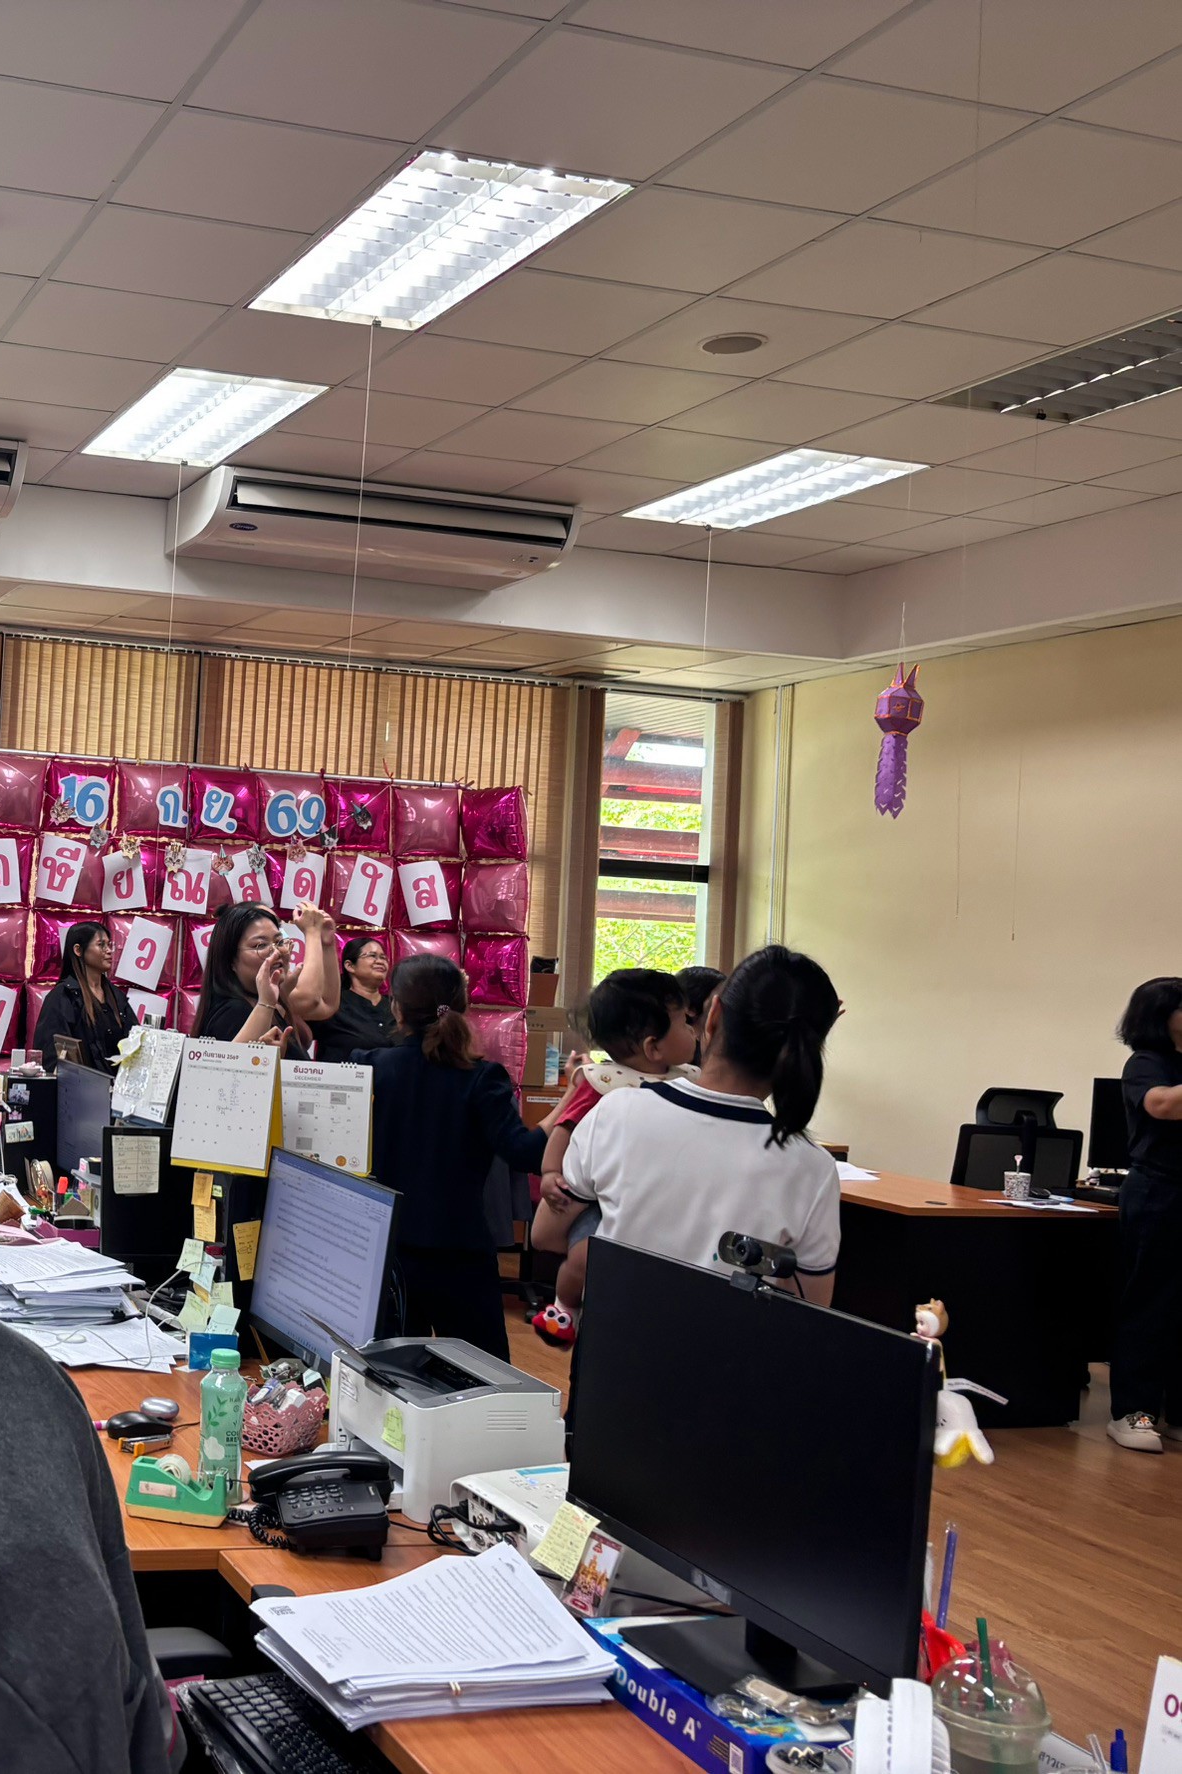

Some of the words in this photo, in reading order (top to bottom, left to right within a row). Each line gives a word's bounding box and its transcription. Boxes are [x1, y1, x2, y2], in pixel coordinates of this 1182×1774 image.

[60, 776, 105, 822] 16
[268, 794, 325, 835] 69
[188, 1050, 202, 1061] 09
[293, 1065, 324, 1075] ธันวาคม
[616, 1664, 677, 1725] Double
[682, 1716, 696, 1741] A
[1164, 1694, 1182, 1722] 0
